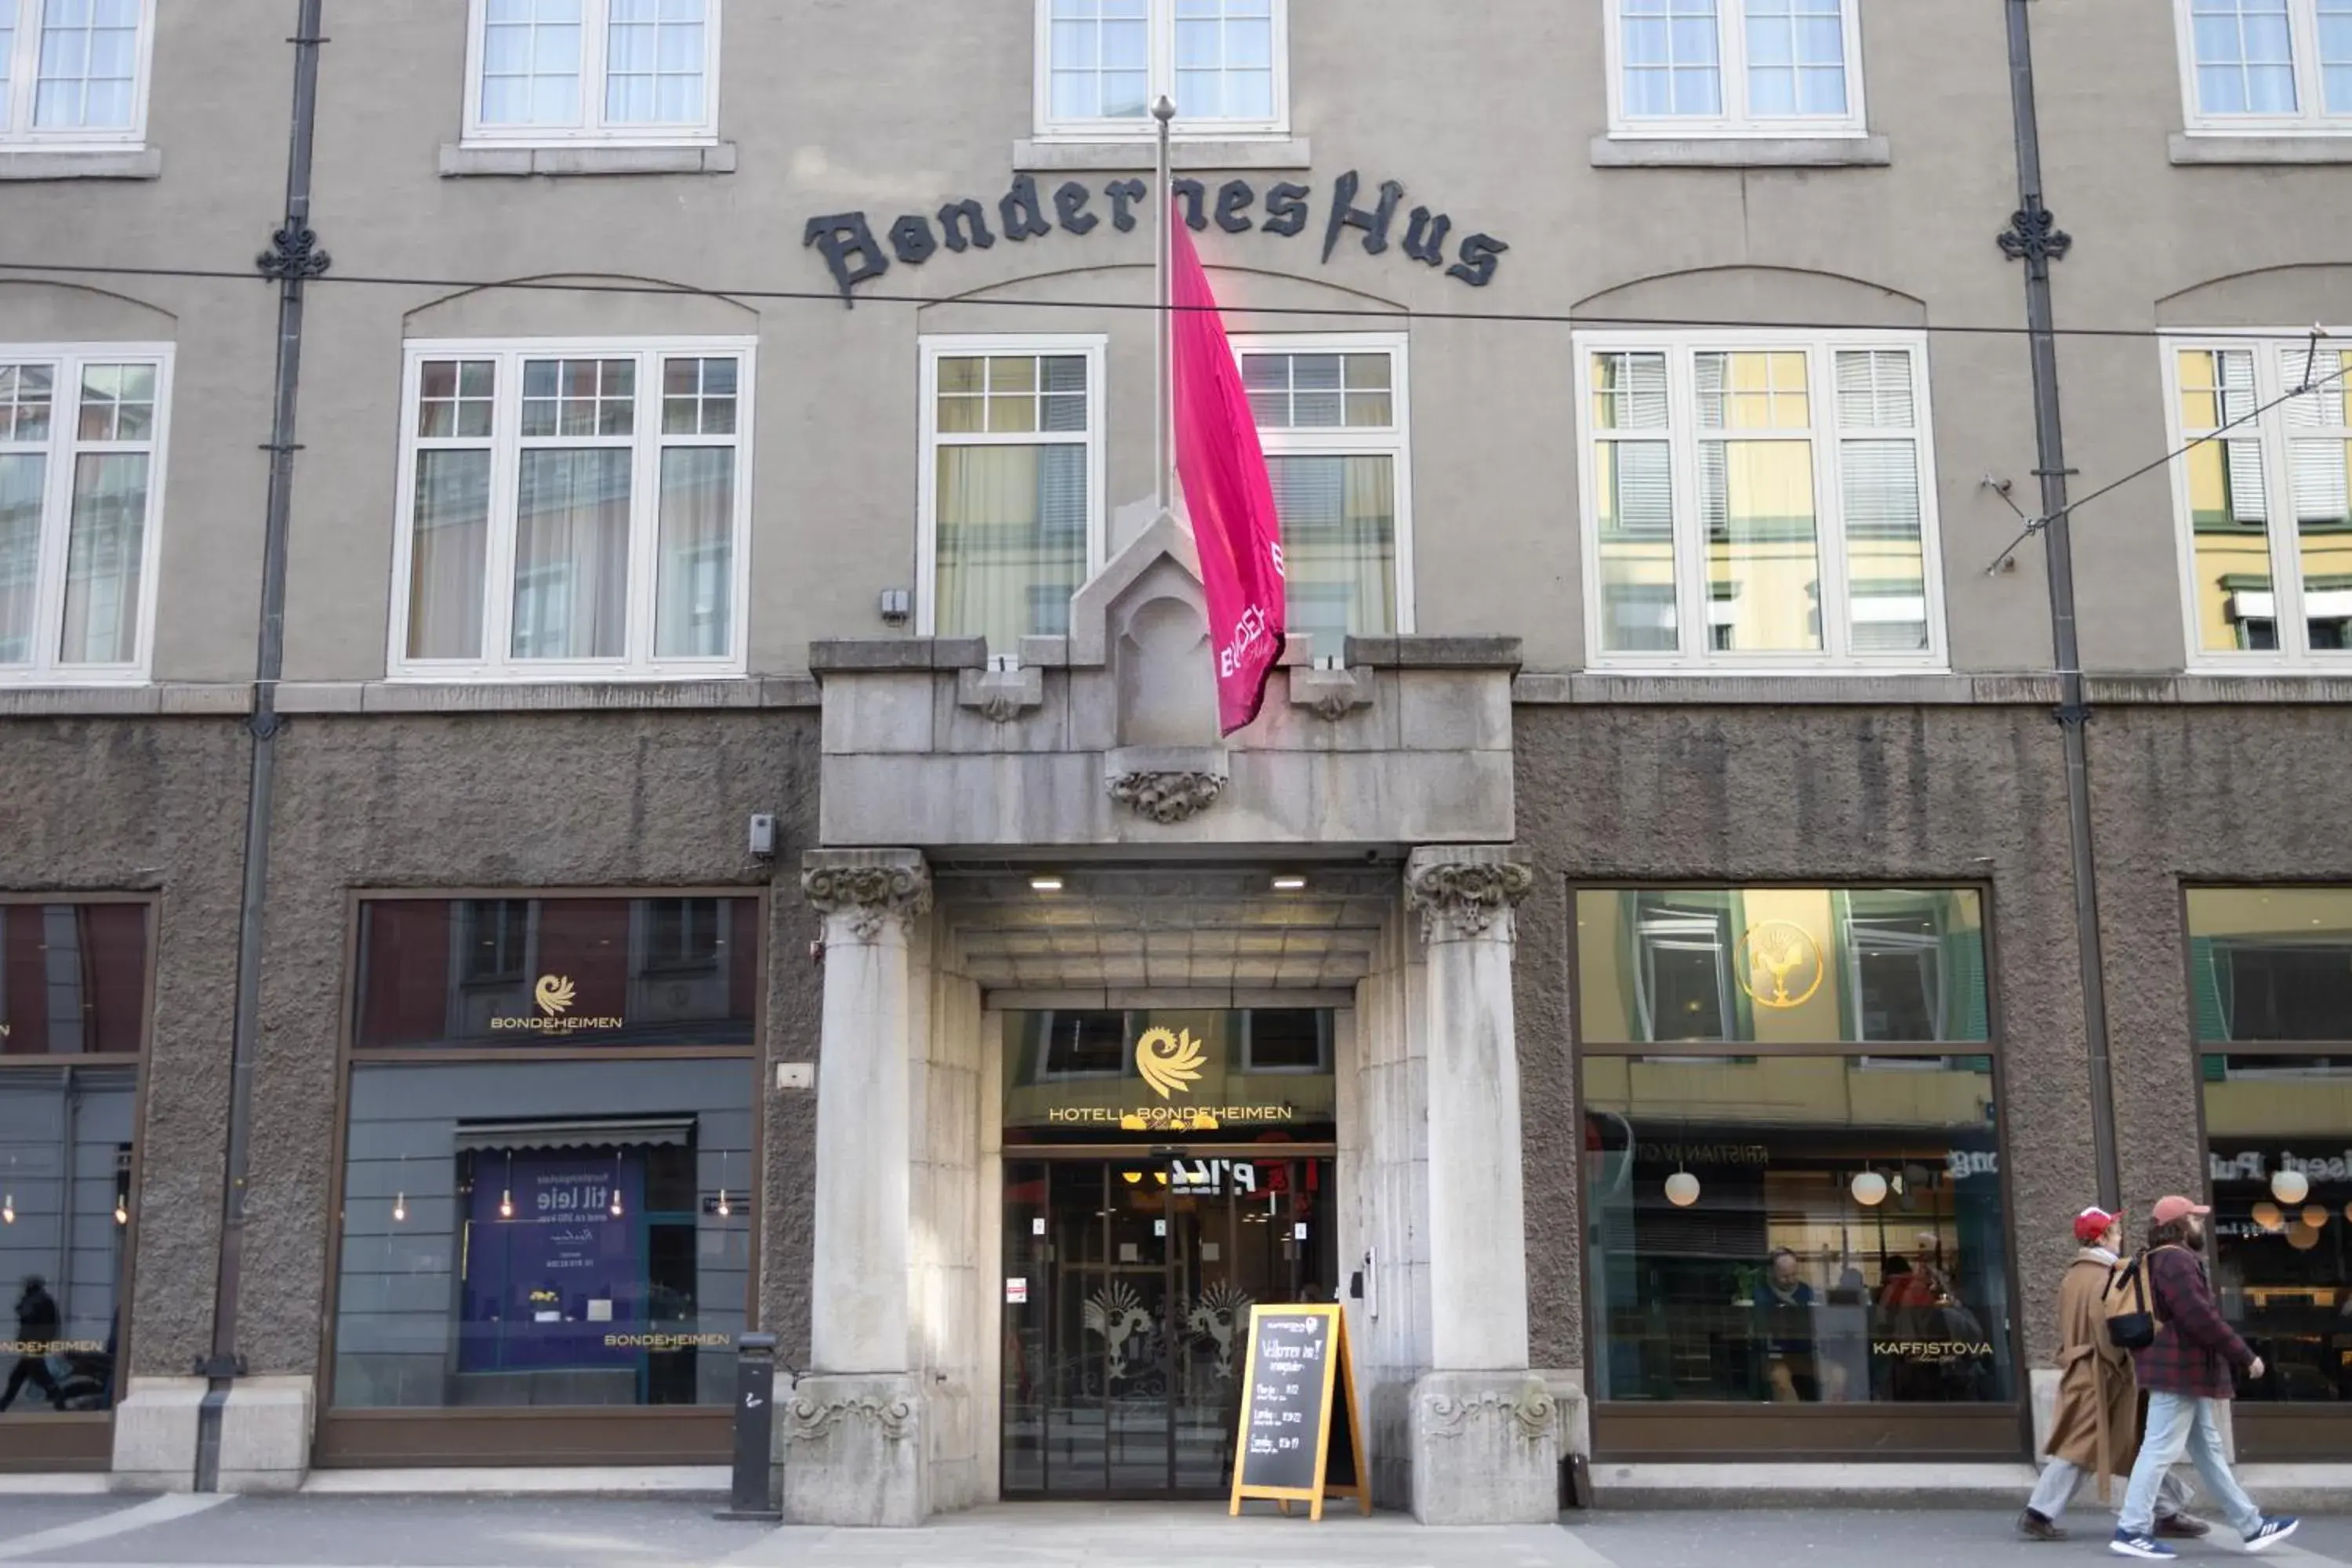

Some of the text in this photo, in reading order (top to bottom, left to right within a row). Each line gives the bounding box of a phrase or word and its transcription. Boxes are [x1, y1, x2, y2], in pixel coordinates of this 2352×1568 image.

[1322, 169, 1509, 286] Hus
[491, 1017, 622, 1029] BONDEHEIMEN
[1049, 1106, 1291, 1120] HOTELL BONDEHEIMEN
[0, 1339, 103, 1353] NDEHEIMEN
[604, 1334, 731, 1347] BONDEHEIMEN
[1872, 1341, 1994, 1355] KAFFISTOVA
